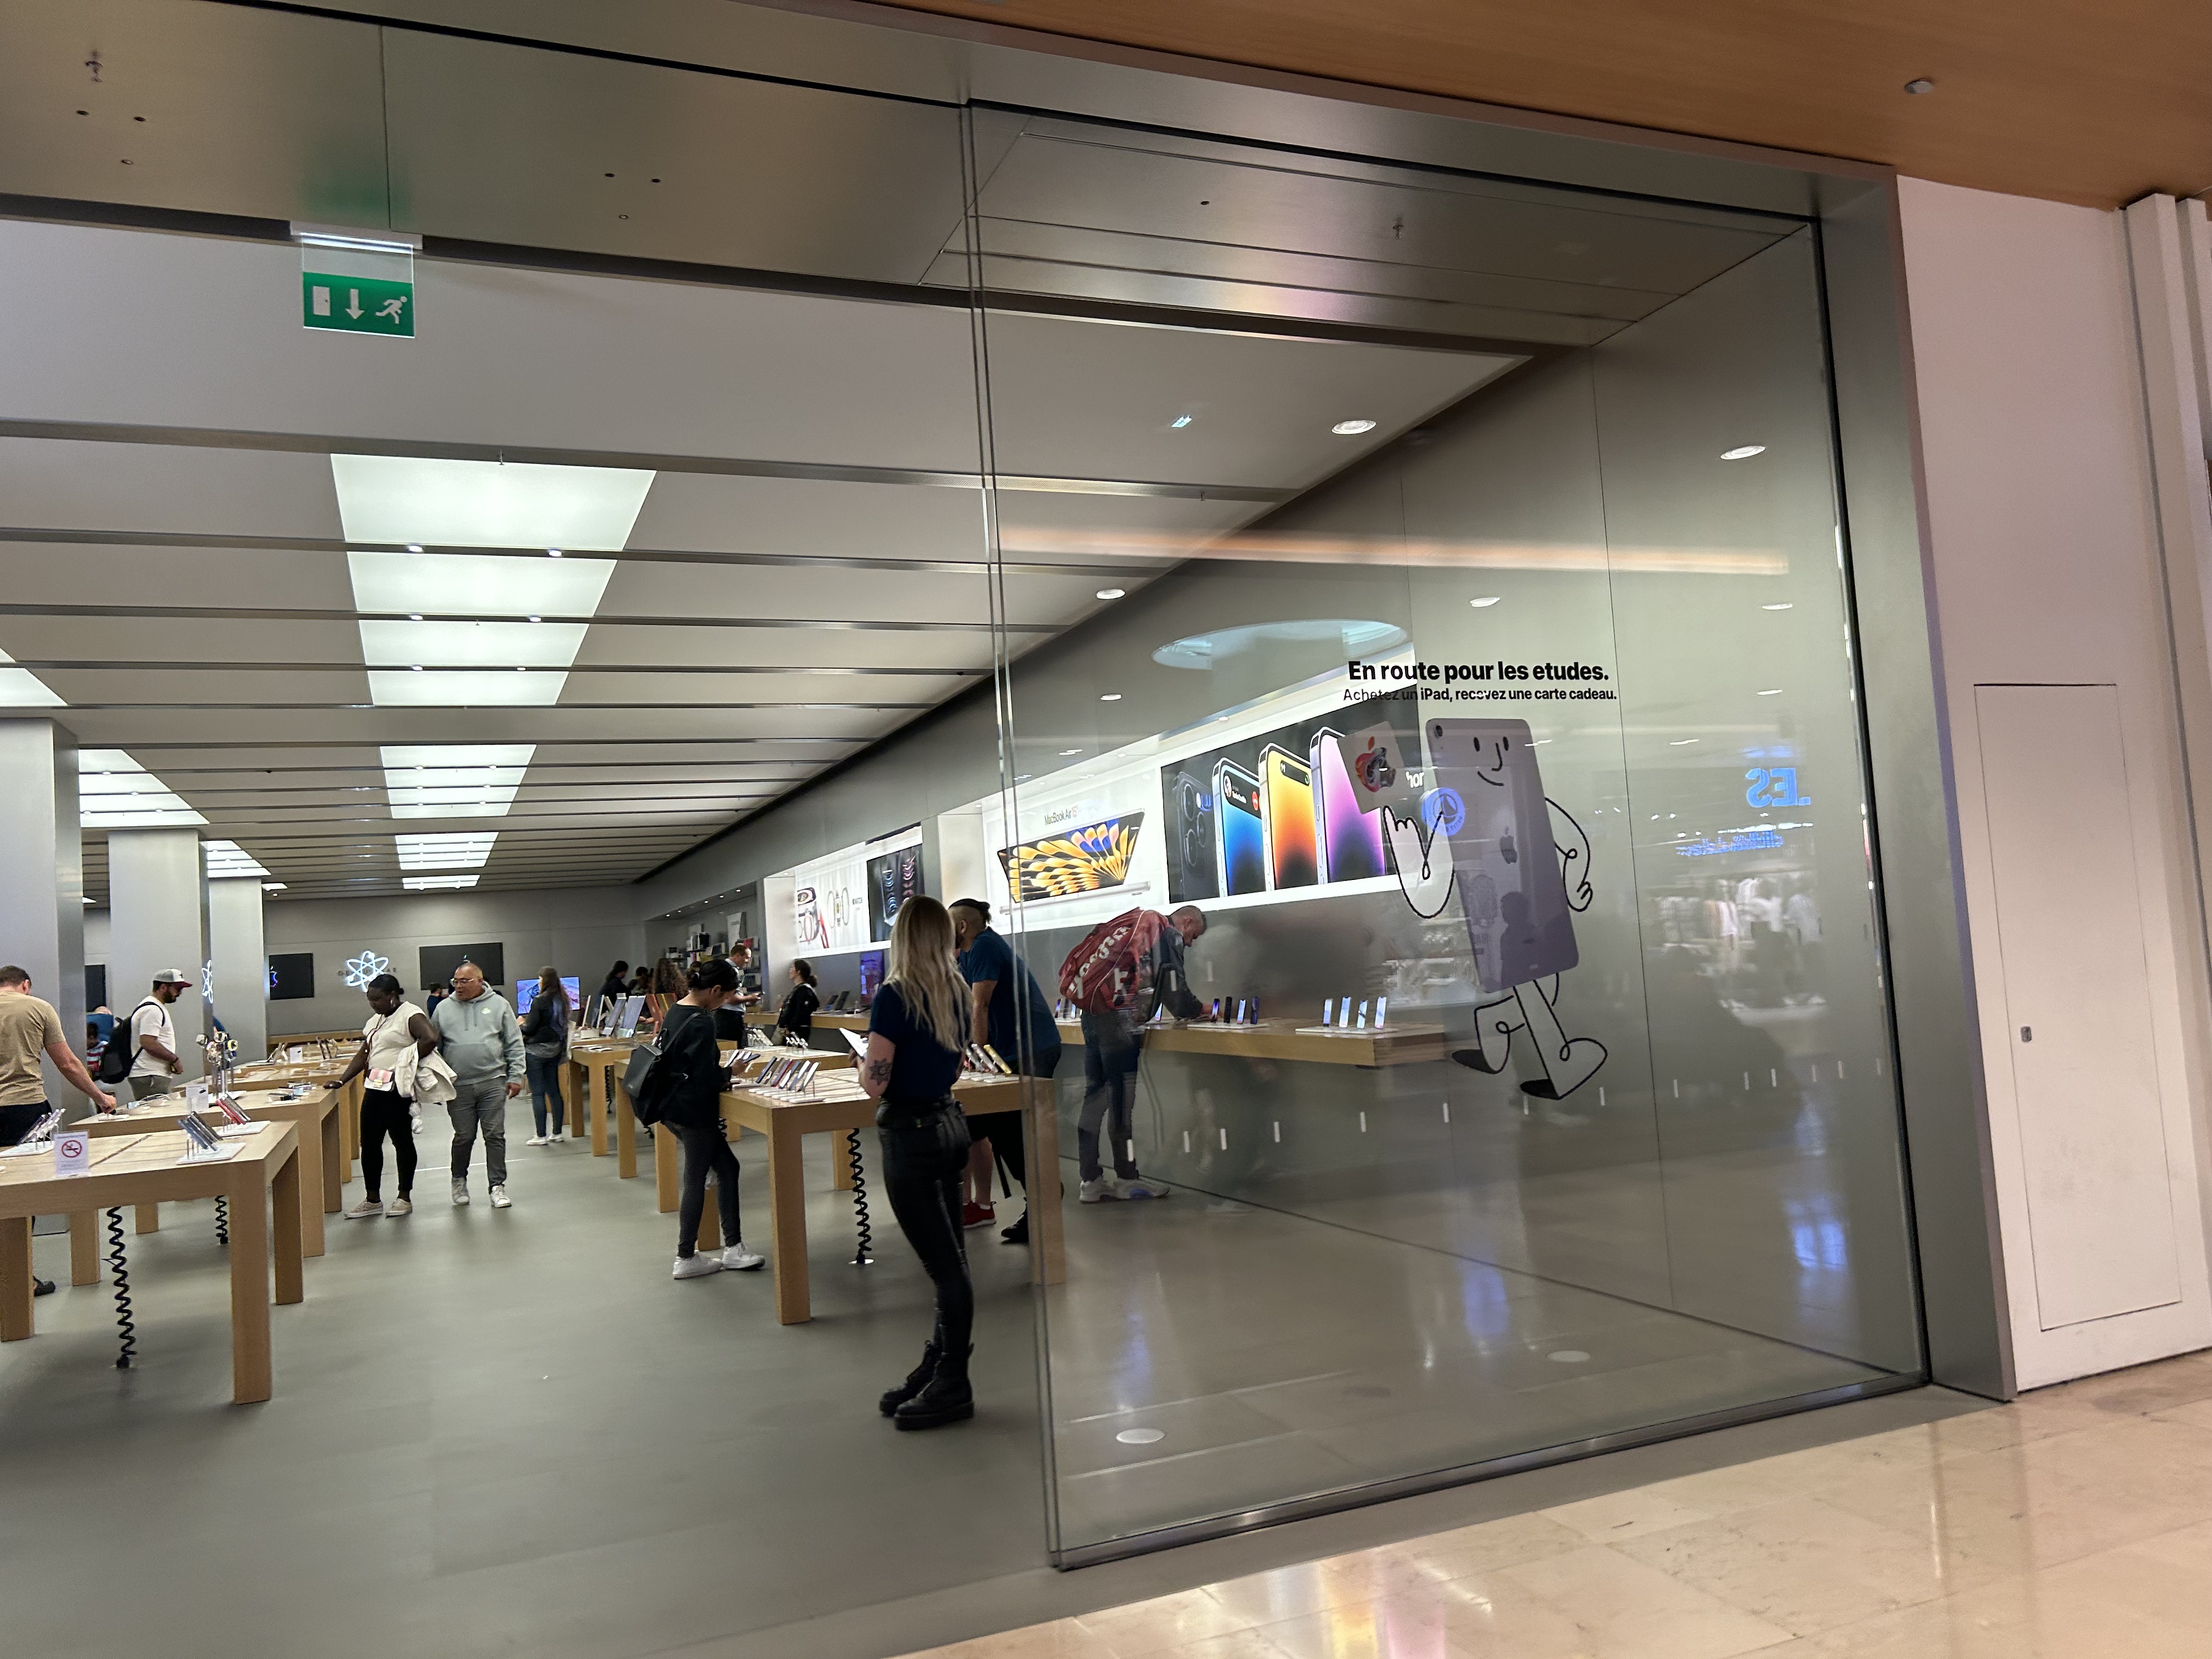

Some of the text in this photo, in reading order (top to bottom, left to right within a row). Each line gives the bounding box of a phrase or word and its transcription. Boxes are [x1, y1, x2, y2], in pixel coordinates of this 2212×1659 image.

[1348, 661, 1609, 684] En route pour les etudes.
[1343, 687, 1617, 702] Achetez un iPad, recevez une carte cadeau.
[1044, 809, 1065, 826] MacBook
